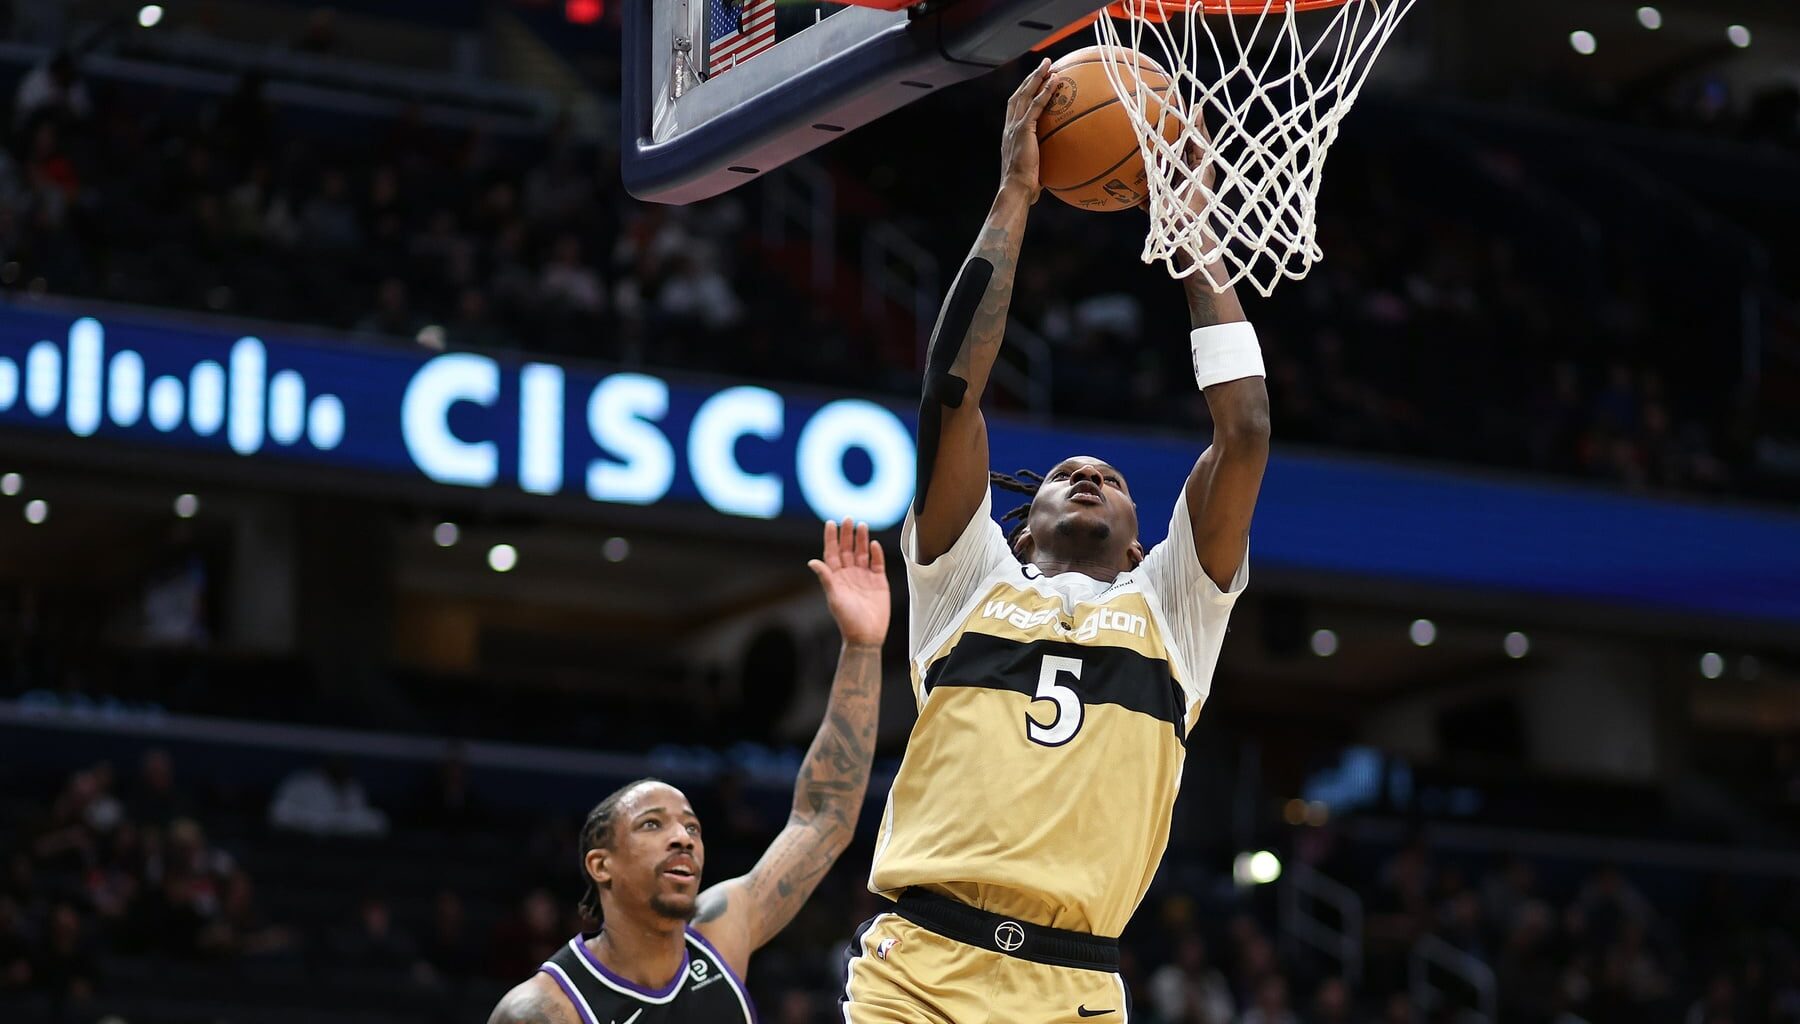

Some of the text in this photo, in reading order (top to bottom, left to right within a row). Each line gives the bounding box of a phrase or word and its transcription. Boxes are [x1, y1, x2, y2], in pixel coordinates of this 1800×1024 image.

[400, 352, 917, 531] CISCO
[982, 599, 1147, 641] washgton
[1025, 654, 1086, 748] 5
